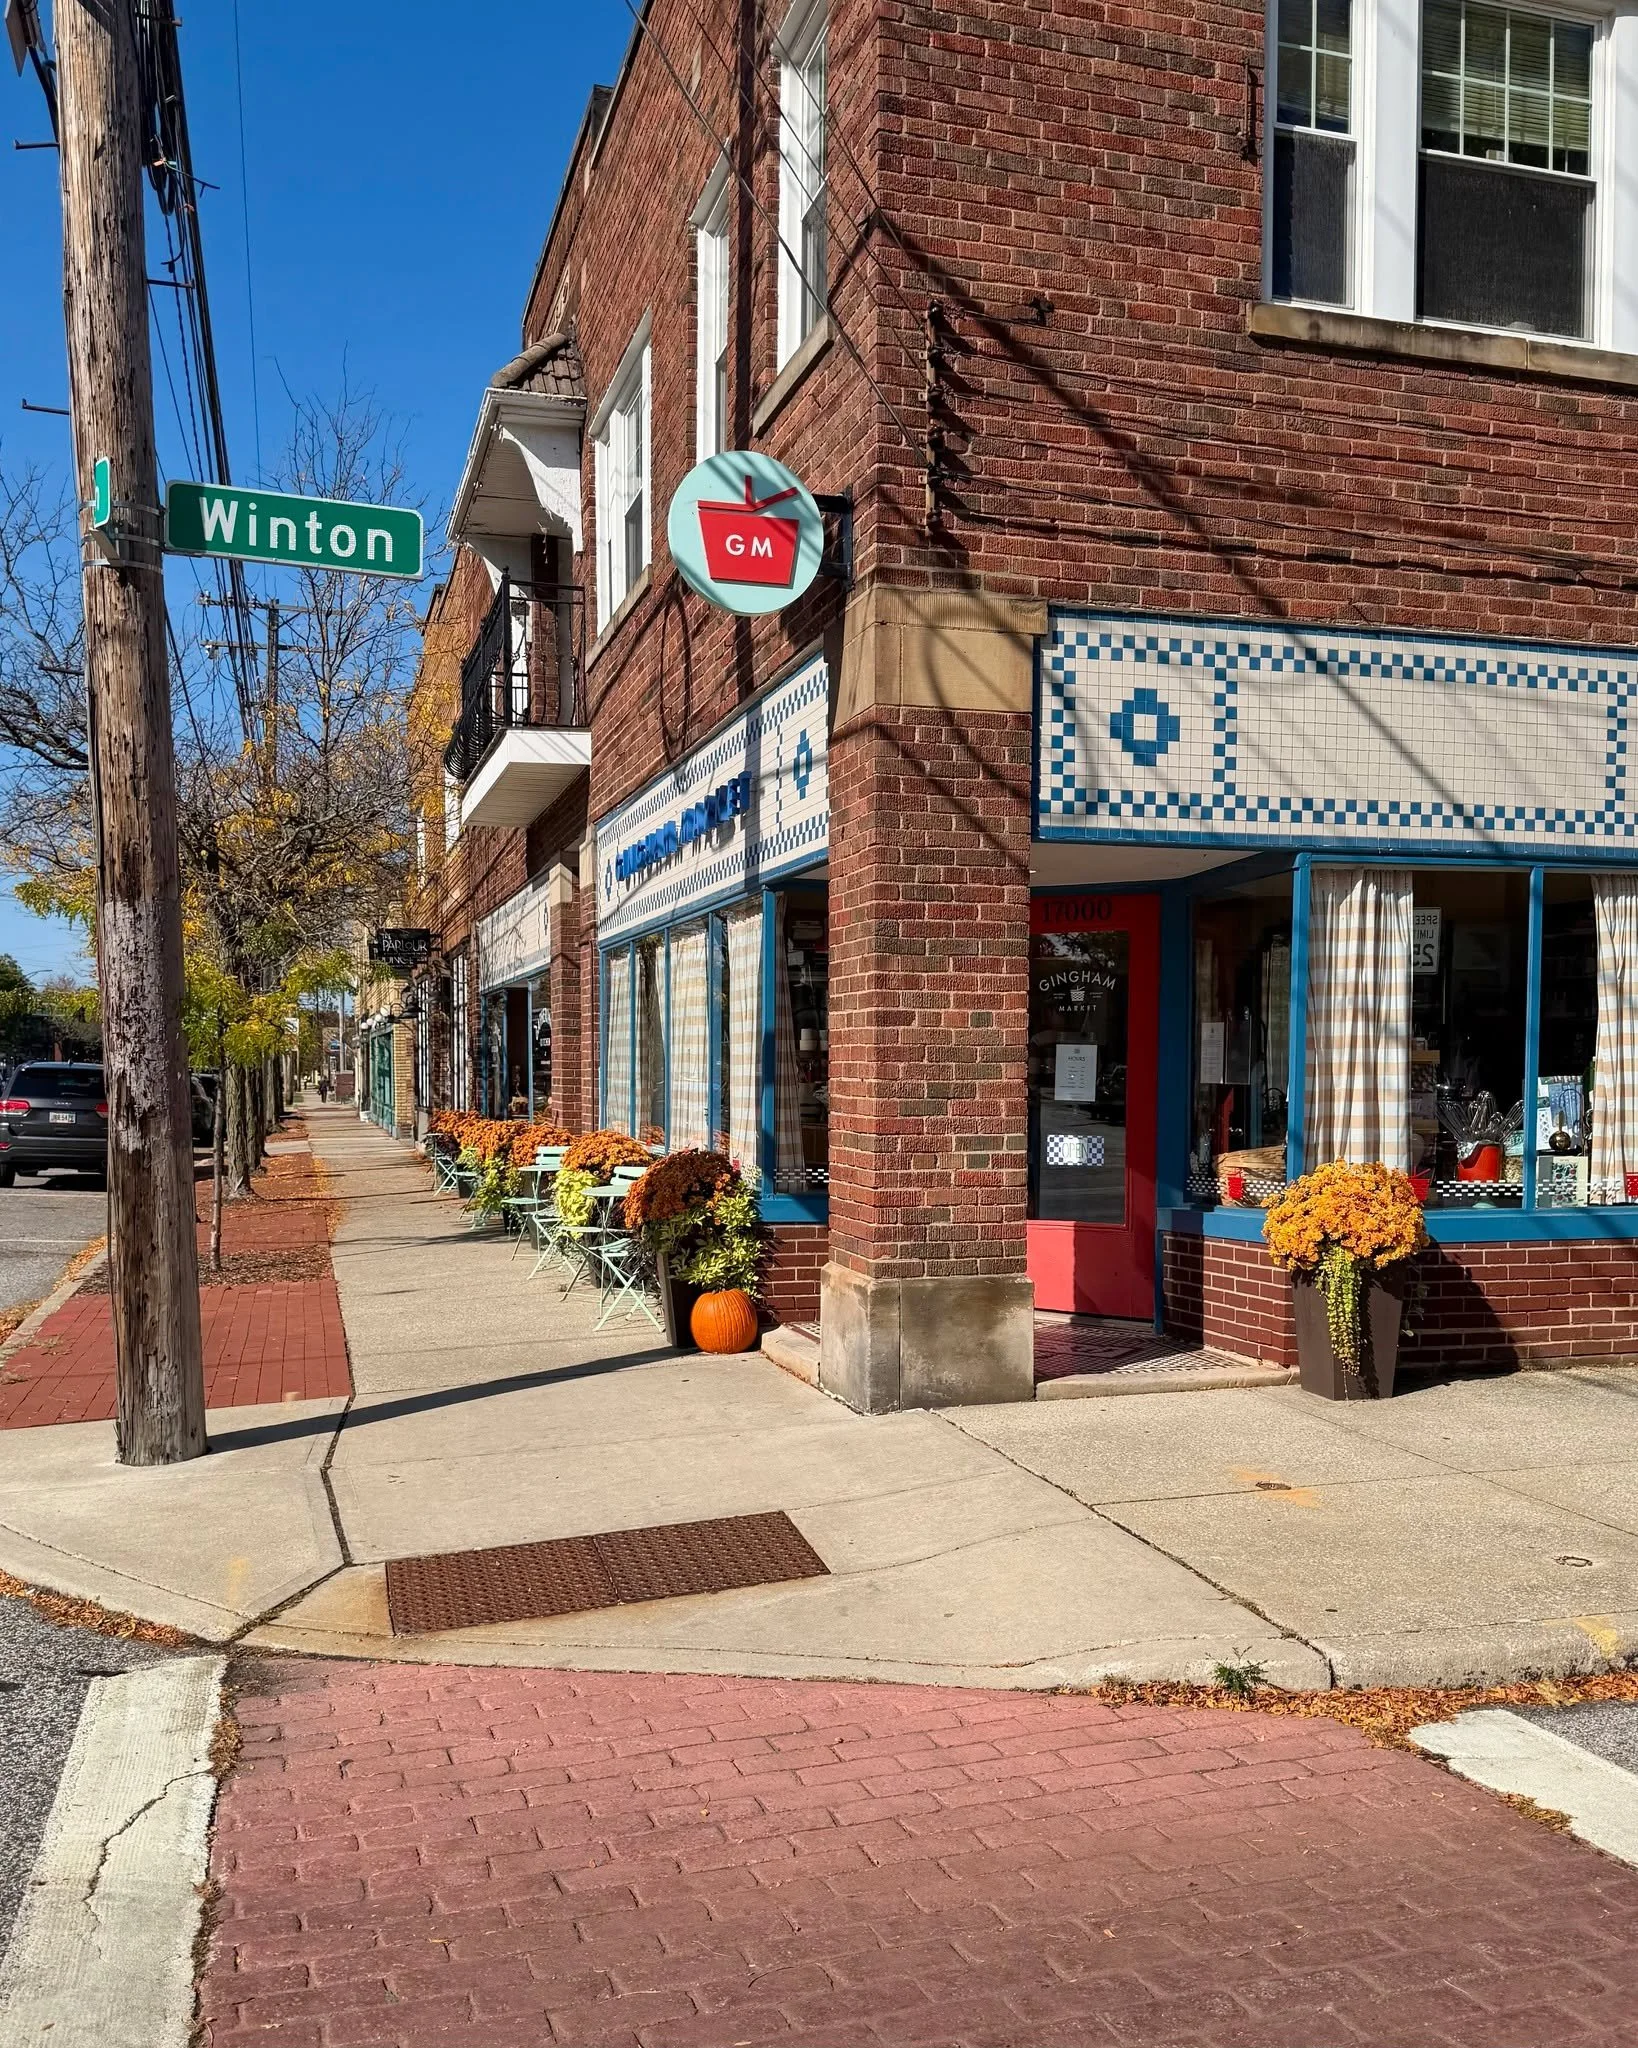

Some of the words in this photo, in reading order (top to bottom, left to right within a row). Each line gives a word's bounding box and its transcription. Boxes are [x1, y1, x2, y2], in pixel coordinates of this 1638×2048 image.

[200, 497, 393, 562] Winton
[725, 534, 773, 558] GM
[1043, 899, 1112, 922] 17000
[1039, 970, 1116, 991] GINGHAM
[1058, 1004, 1097, 1012] MARKET
[1061, 1142, 1088, 1159] OPEN
